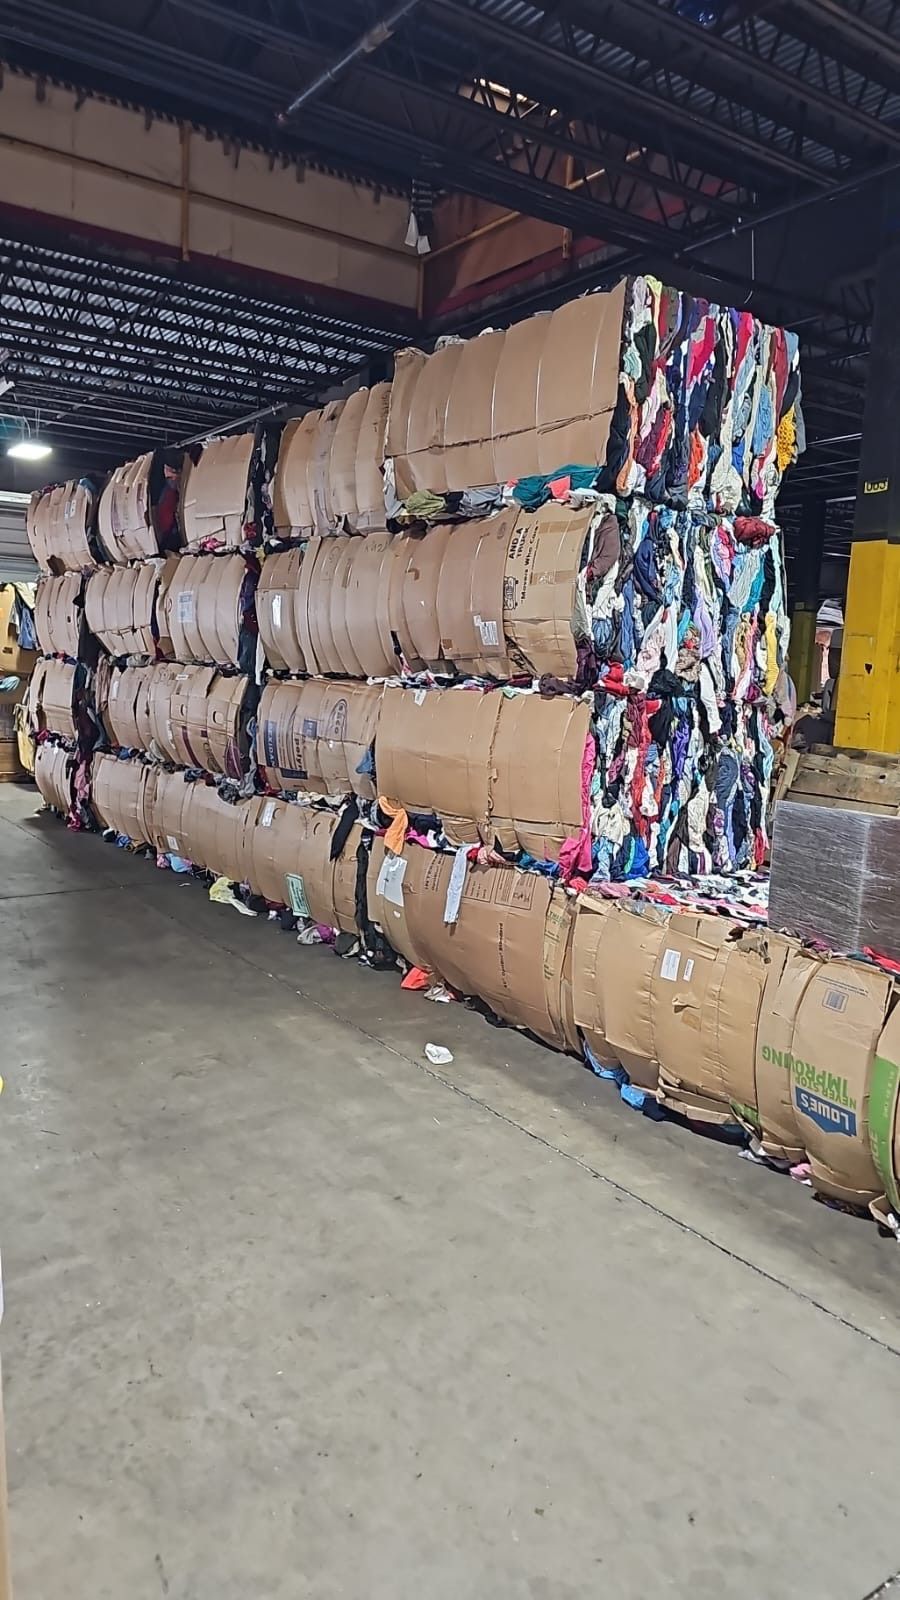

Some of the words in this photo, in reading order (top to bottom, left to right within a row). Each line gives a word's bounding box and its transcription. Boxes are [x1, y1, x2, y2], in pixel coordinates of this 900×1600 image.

[508, 537, 519, 560] AND
[516, 527, 524, 536] A
[524, 546, 532, 566] Who
[762, 1045, 848, 1100] IMPROVING
[800, 1092, 850, 1132] LOWE'S
[821, 1086, 857, 1111] NEVER
